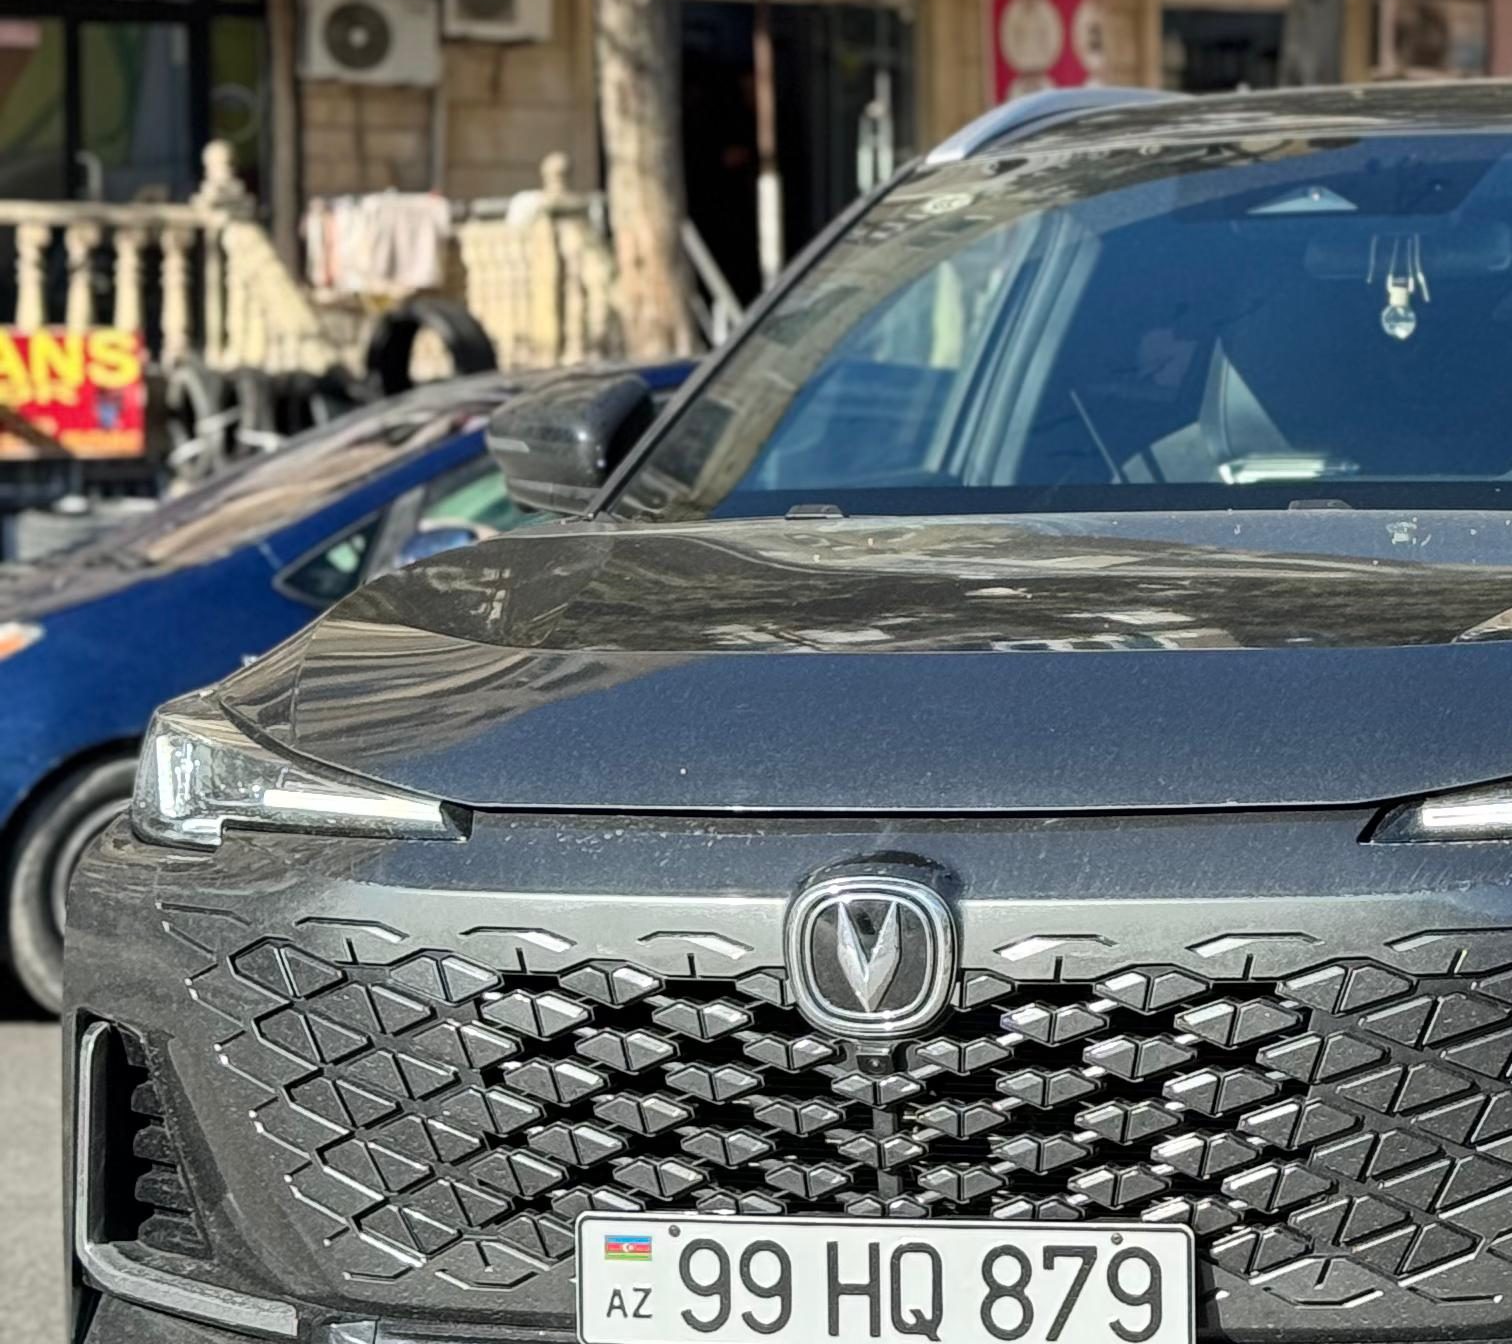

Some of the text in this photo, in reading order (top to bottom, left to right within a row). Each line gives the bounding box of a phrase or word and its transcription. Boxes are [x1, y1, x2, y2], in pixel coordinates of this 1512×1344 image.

[605, 1287, 653, 1320] AZ
[678, 1238, 1164, 1344] 99 HQ 879
